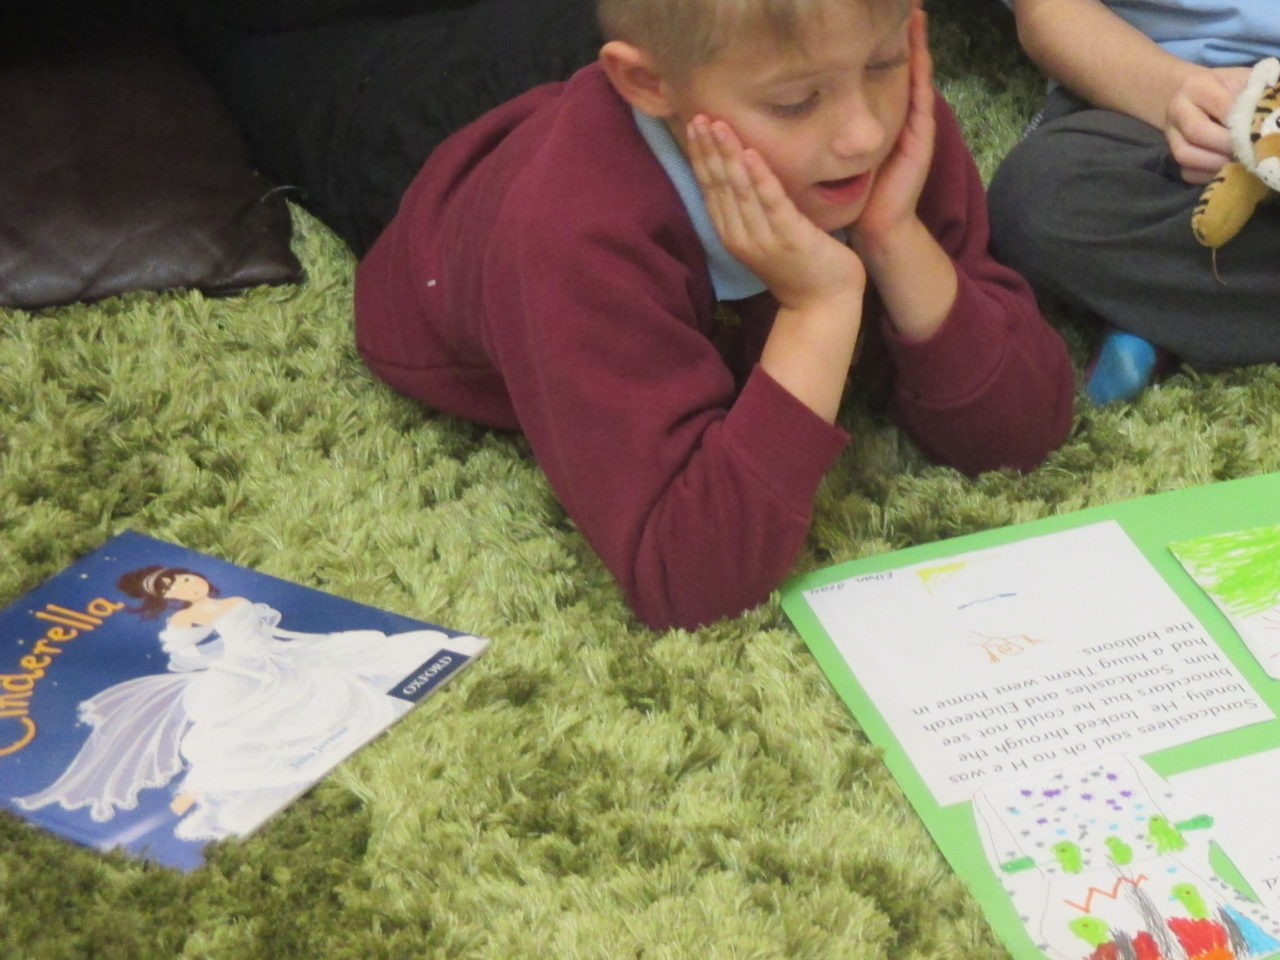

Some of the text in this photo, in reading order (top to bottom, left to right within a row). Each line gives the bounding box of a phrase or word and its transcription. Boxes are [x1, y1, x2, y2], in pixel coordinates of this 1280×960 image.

[1165, 621, 1194, 634] the
[1153, 647, 1164, 657] a
[1170, 637, 1208, 653] had
[402, 656, 452, 694] OXFORD
[1065, 663, 1174, 695] Sandcastles
[996, 678, 1038, 695] went
[936, 690, 989, 709] home
[942, 667, 1233, 747] binoculars but he could not see
[1024, 692, 1058, 708] and
[1152, 700, 1178, 712] He
[912, 705, 929, 716] in
[1075, 710, 1140, 734] looked
[994, 727, 1069, 754] through
[1093, 730, 1131, 749] said
[959, 749, 988, 762] the
[1033, 751, 1056, 762] no
[1063, 743, 1086, 756] oh
[949, 769, 986, 783] was
